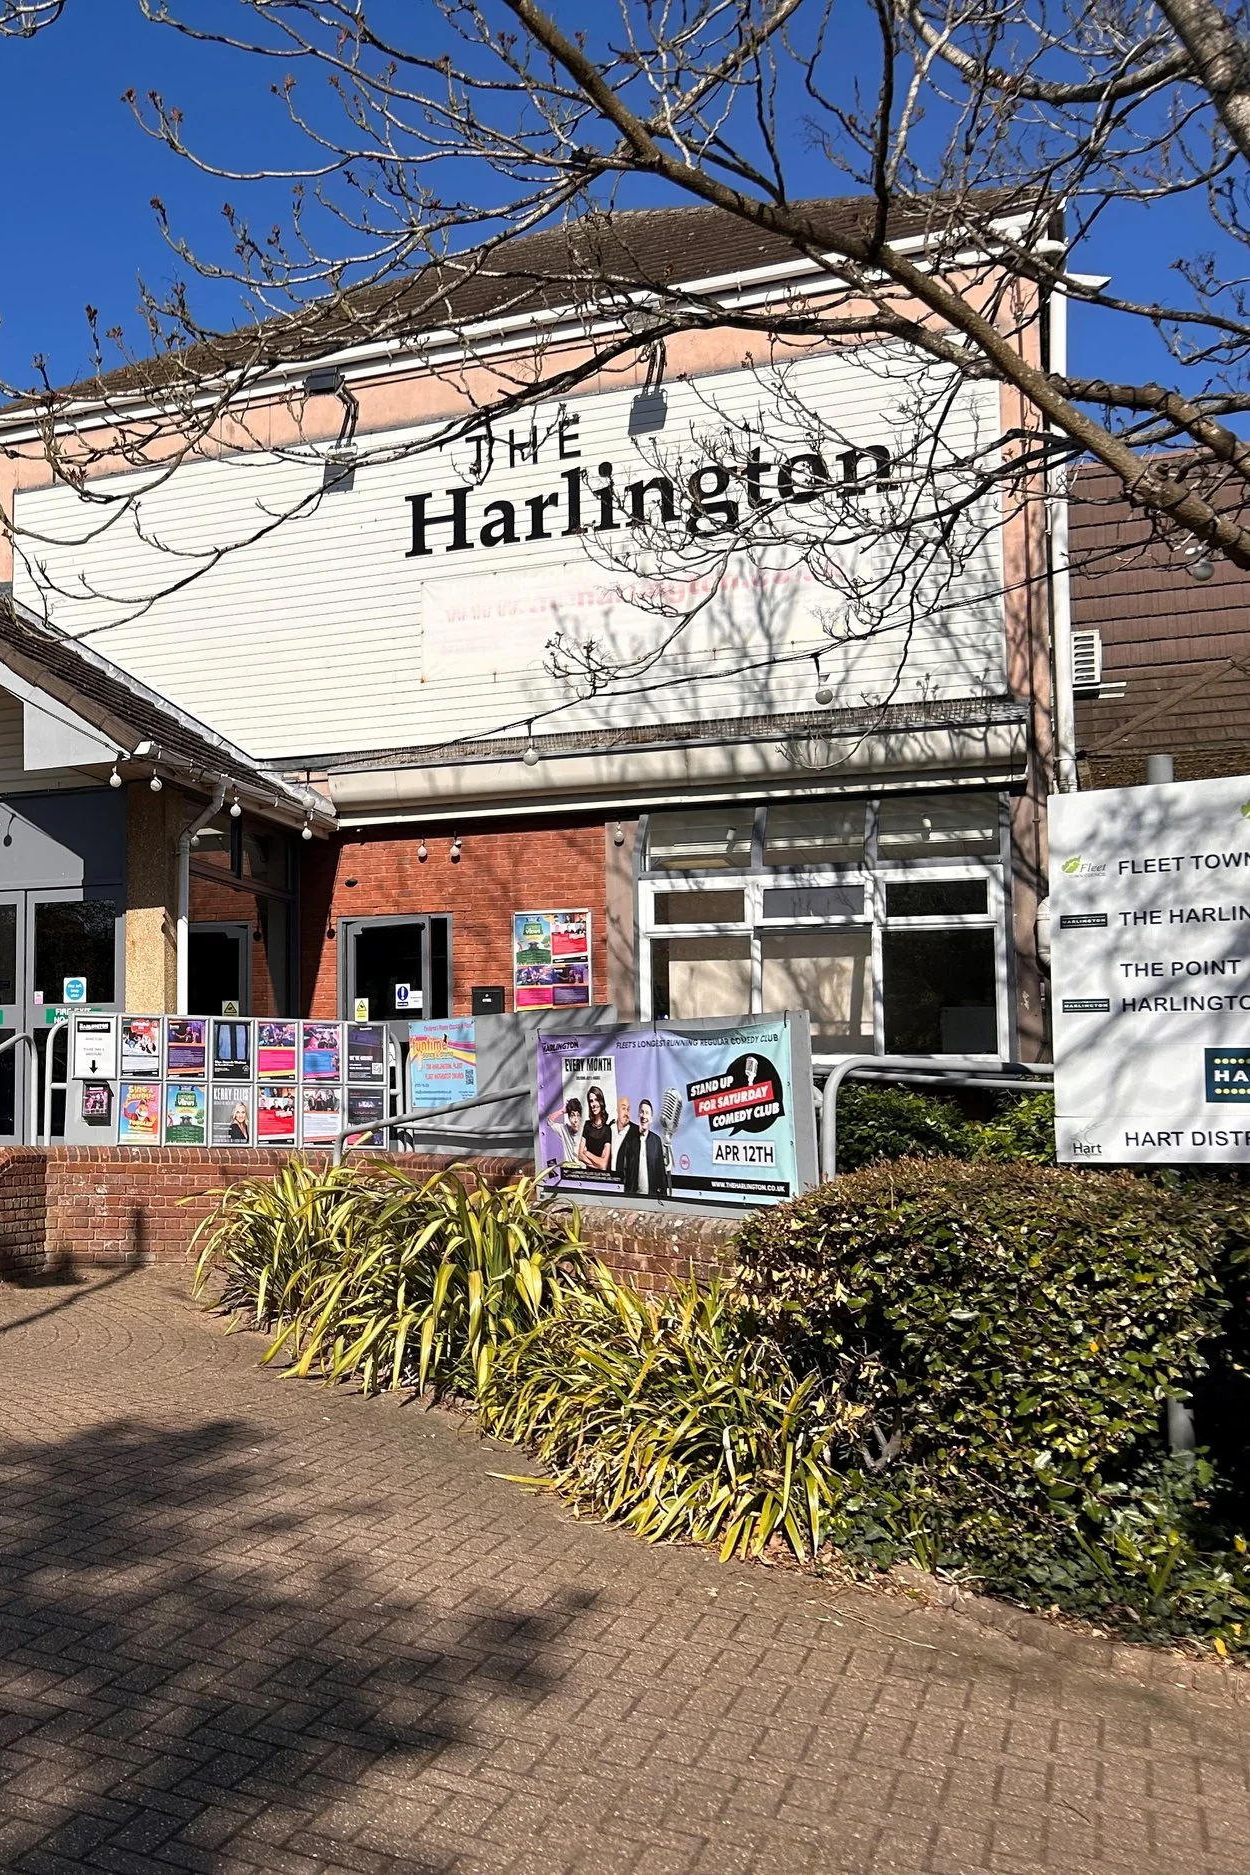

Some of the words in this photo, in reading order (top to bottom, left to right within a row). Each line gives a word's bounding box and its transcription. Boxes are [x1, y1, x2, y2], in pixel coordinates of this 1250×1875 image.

[465, 419, 581, 470] THE
[405, 445, 899, 558] Harlington
[1080, 863, 1107, 872] Fleet
[1119, 856, 1185, 875] FLEET
[1119, 911, 1162, 926] THE
[1120, 962, 1164, 977] THE
[1171, 960, 1241, 976] POINT
[616, 1041, 637, 1049] FLEET'S
[637, 1039, 666, 1048] LONGEST
[699, 1038, 730, 1046] REGULAR
[731, 1035, 759, 1045] COMEDY
[760, 1033, 779, 1042] CLUB
[564, 1058, 586, 1072] EVERY
[586, 1057, 612, 1072] MONTH
[213, 1087, 232, 1101] KERRY
[233, 1087, 248, 1101] ELLIS
[690, 1079, 719, 1097] STAND
[719, 1075, 734, 1089] UP
[698, 1099, 716, 1113] FOR
[717, 1085, 769, 1109] SATURDAY
[712, 1110, 753, 1128] COMEDY
[753, 1102, 780, 1118] CLUB
[1125, 1132, 1183, 1146] HART
[715, 1144, 740, 1162] APR
[742, 1145, 774, 1163] 12TH
[1073, 1143, 1102, 1155] Hart
[711, 1180, 786, 1193] WWW.THEHARLINGTON.CO.UK
